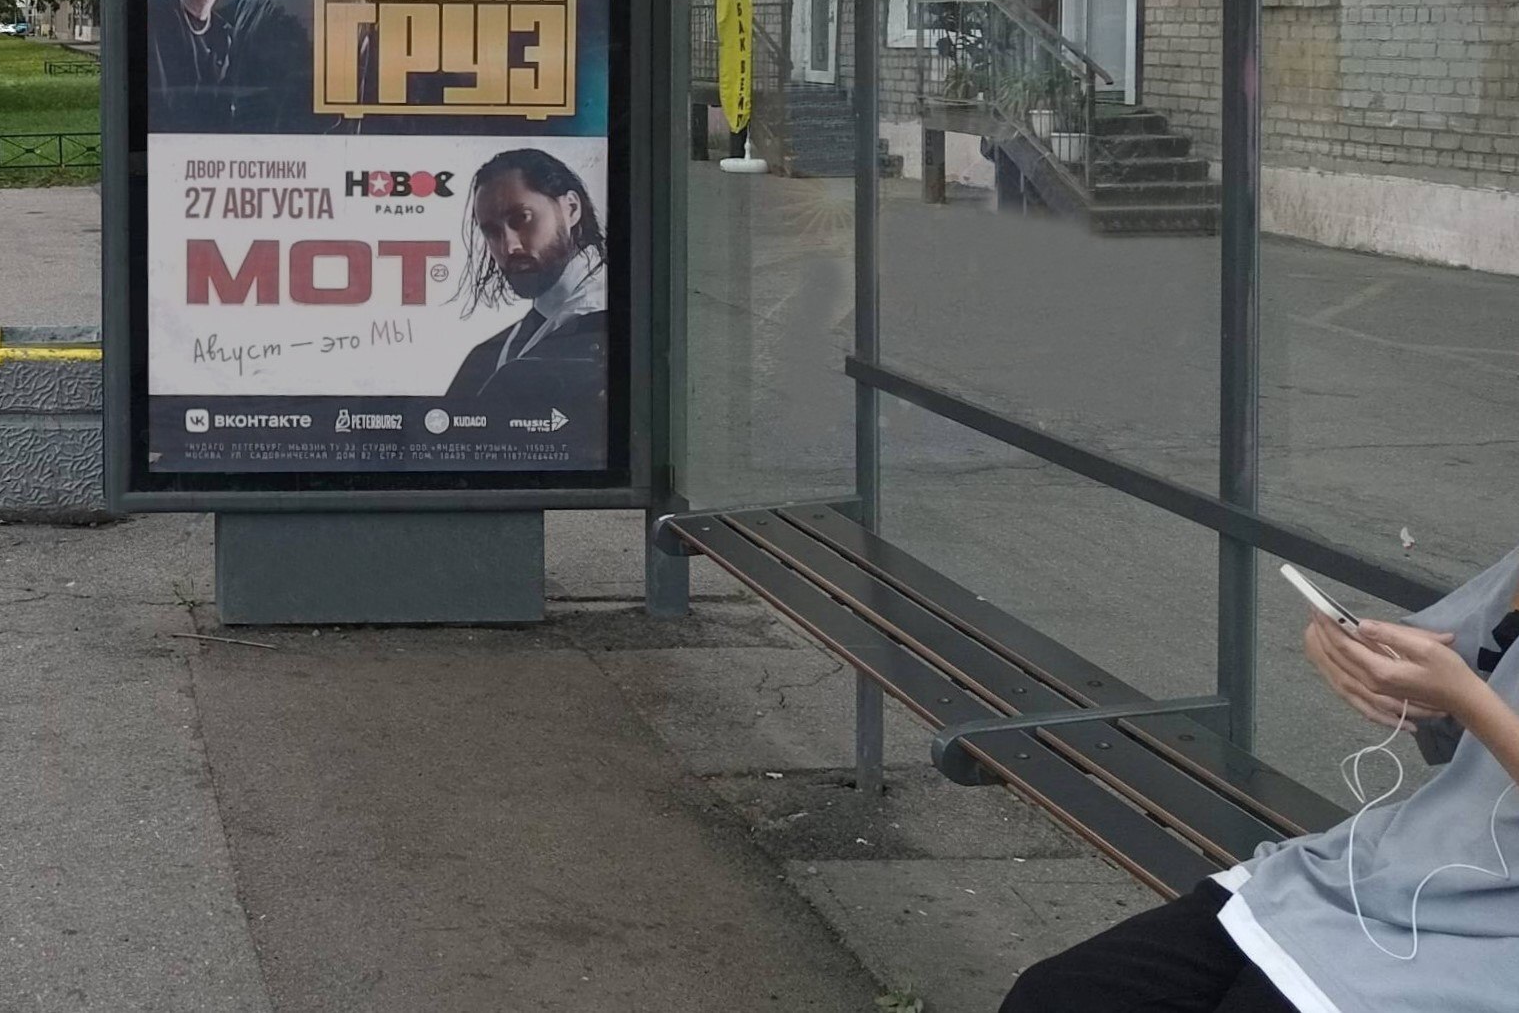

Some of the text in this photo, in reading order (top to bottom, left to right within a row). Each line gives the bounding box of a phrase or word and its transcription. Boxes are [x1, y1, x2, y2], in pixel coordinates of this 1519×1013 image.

[325, 3, 566, 105] ГРУЗ
[185, 160, 307, 180] ДВОР ГОСТИНКИ
[185, 188, 334, 219] 27 АВГУСТА
[375, 204, 425, 215] РАДИО
[186, 239, 451, 306] МОТ
[433, 267, 448, 279] 23
[194, 334, 281, 376] Август
[320, 335, 360, 352] это
[371, 319, 413, 347] МЫ
